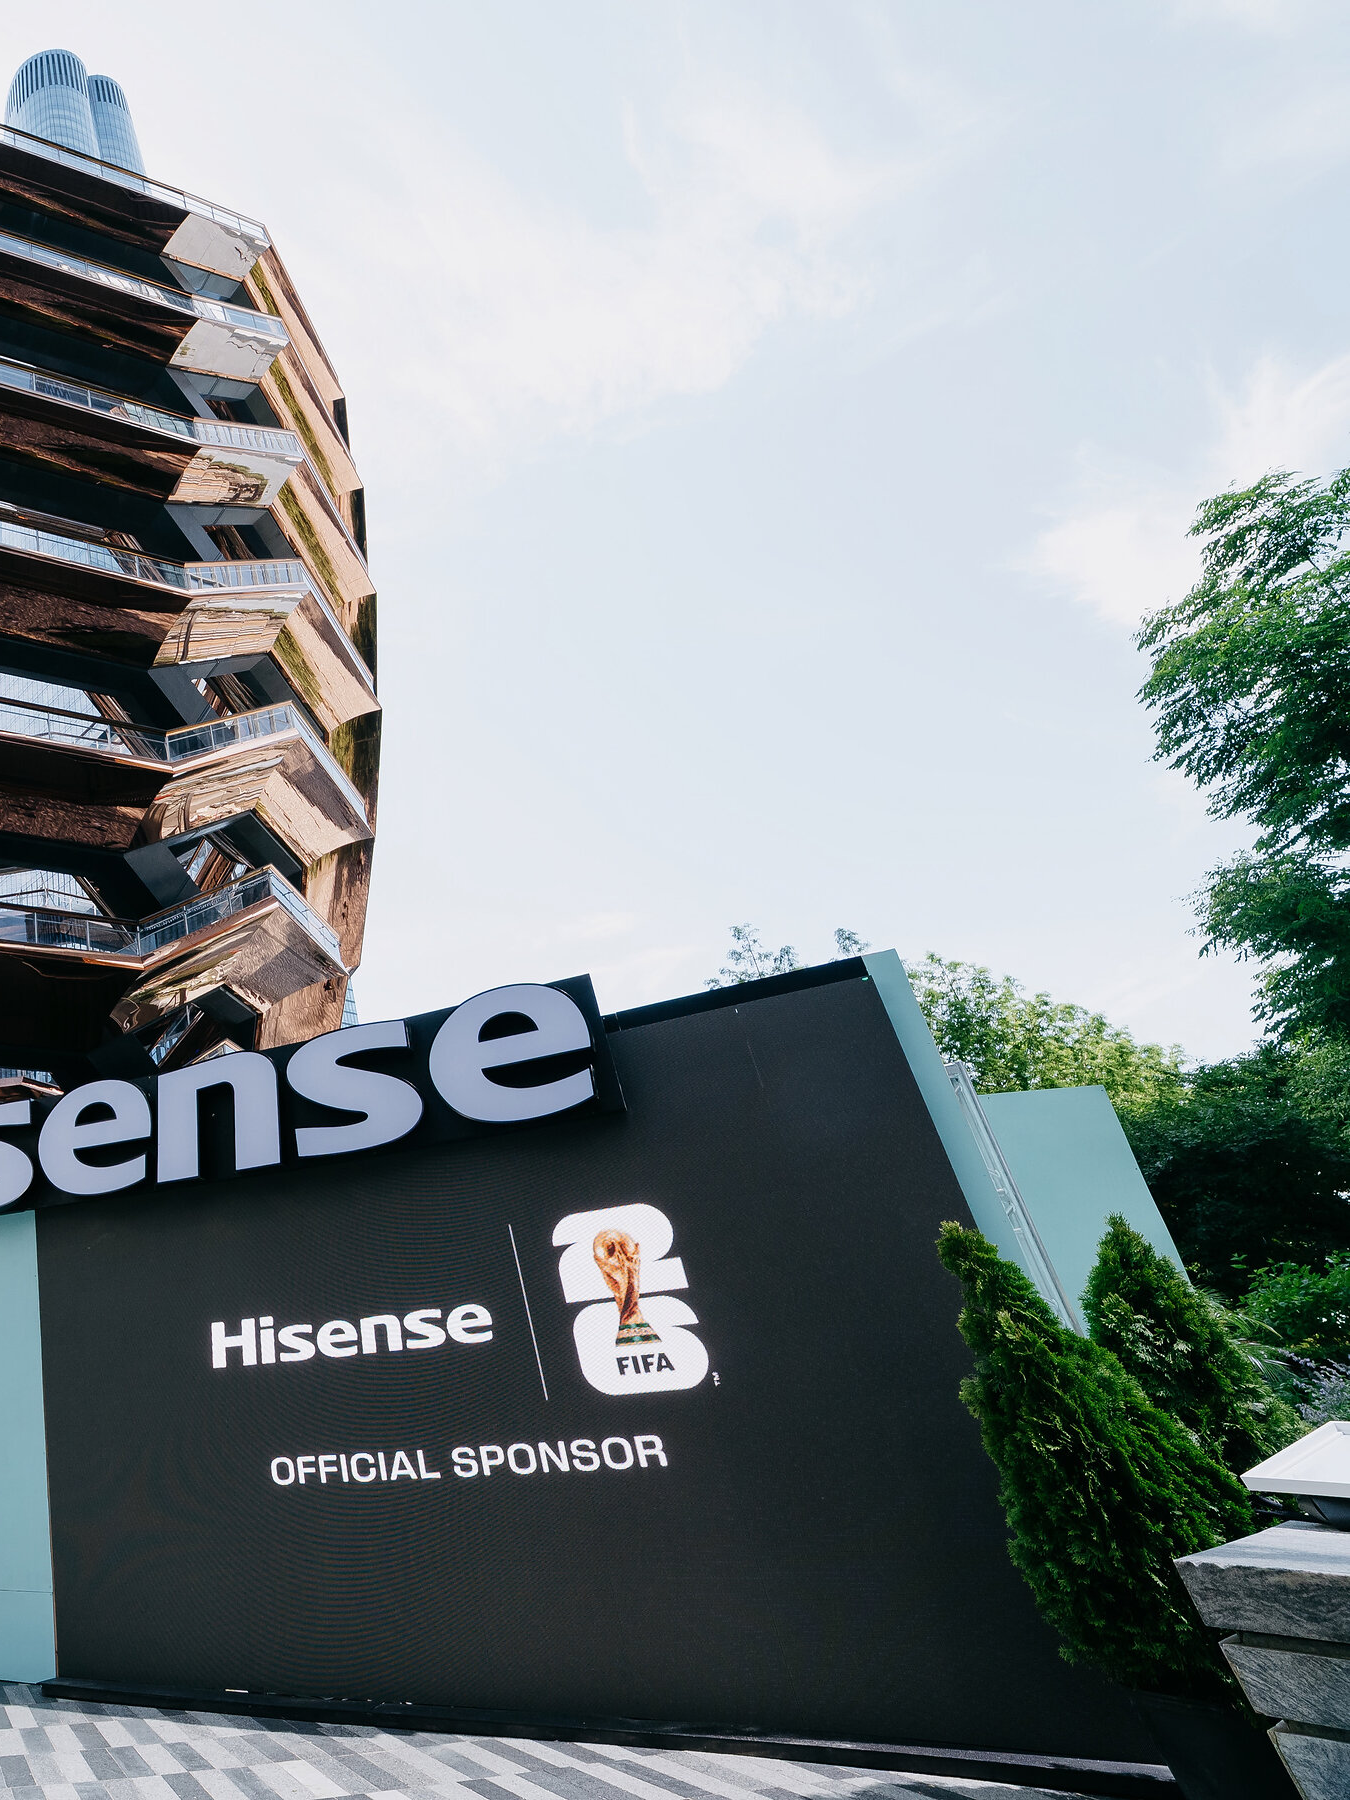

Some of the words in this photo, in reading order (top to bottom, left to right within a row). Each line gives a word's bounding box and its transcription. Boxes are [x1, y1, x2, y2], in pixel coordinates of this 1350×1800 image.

[210, 1304, 494, 1369] Hisense
[615, 1352, 676, 1376] FIFA
[270, 1449, 442, 1486] OFFICIAL
[451, 1434, 669, 1478] SPONSOR
